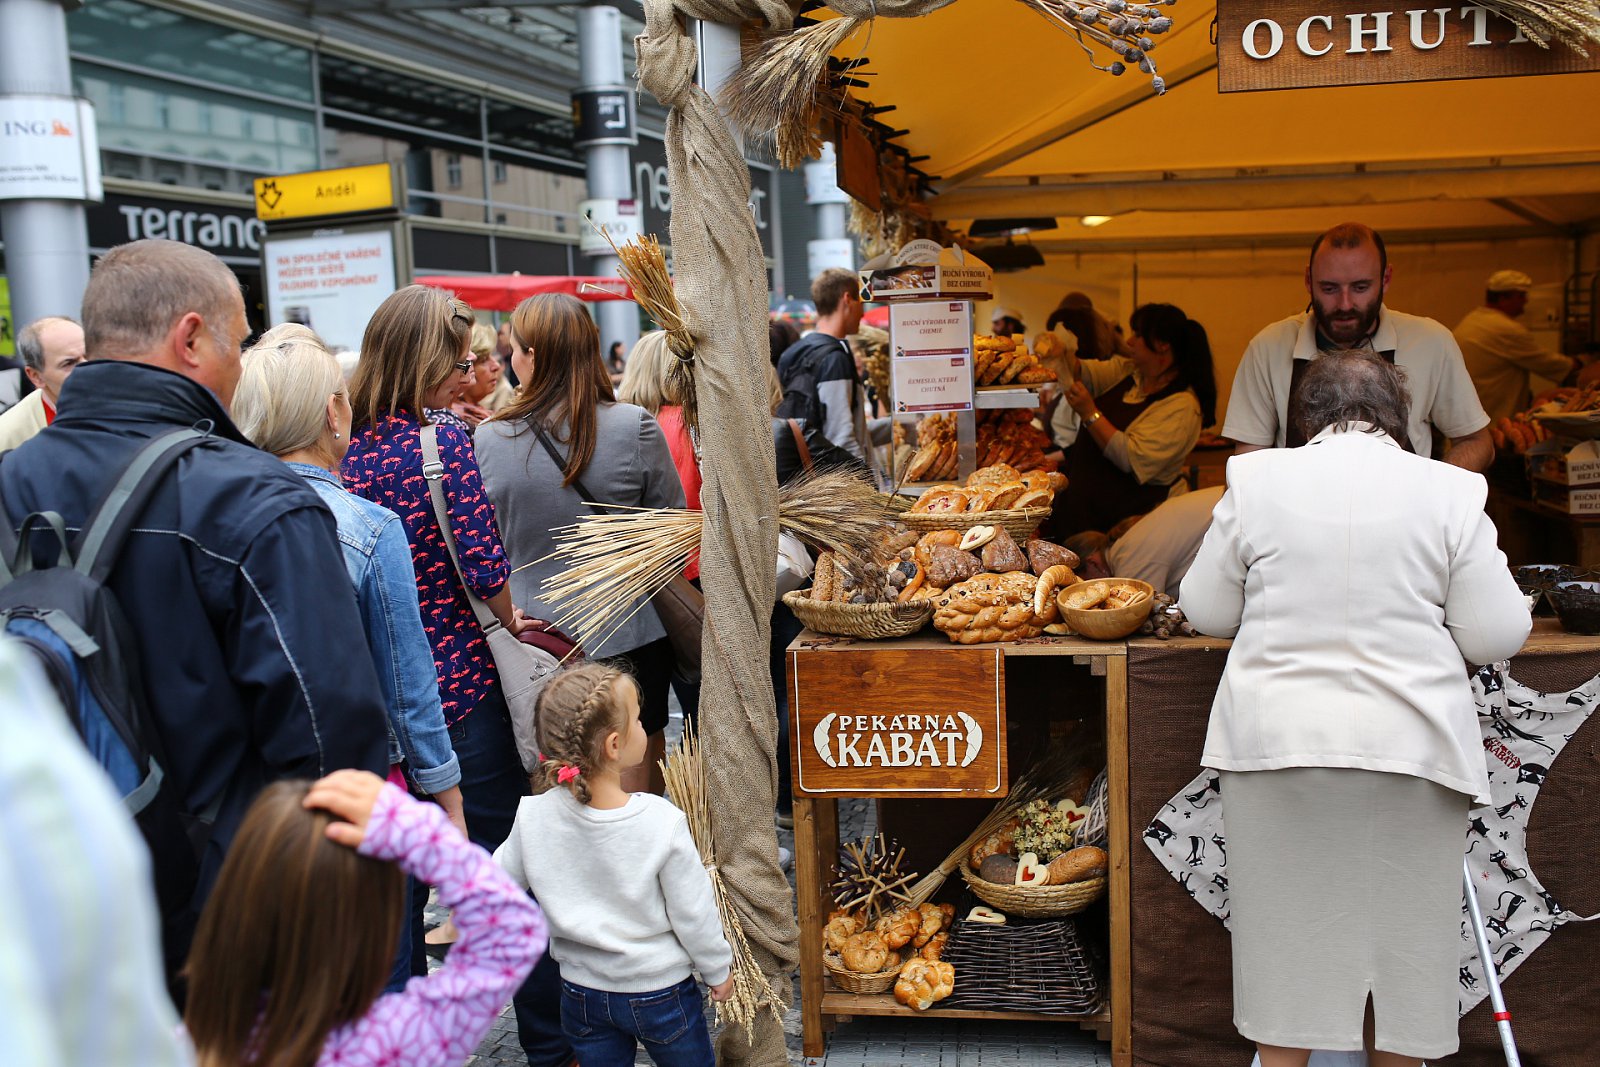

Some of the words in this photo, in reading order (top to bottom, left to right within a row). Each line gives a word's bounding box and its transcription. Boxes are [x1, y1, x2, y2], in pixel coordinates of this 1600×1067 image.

[4, 121, 46, 136] ING
[942, 269, 961, 278] RUČNÍ
[947, 280, 959, 288] BEZ
[960, 280, 982, 288] CHEMIE
[902, 318, 920, 326] RUČNÍ
[839, 713, 958, 730] PEKÁRNA
[836, 730, 963, 767] KABÁT
